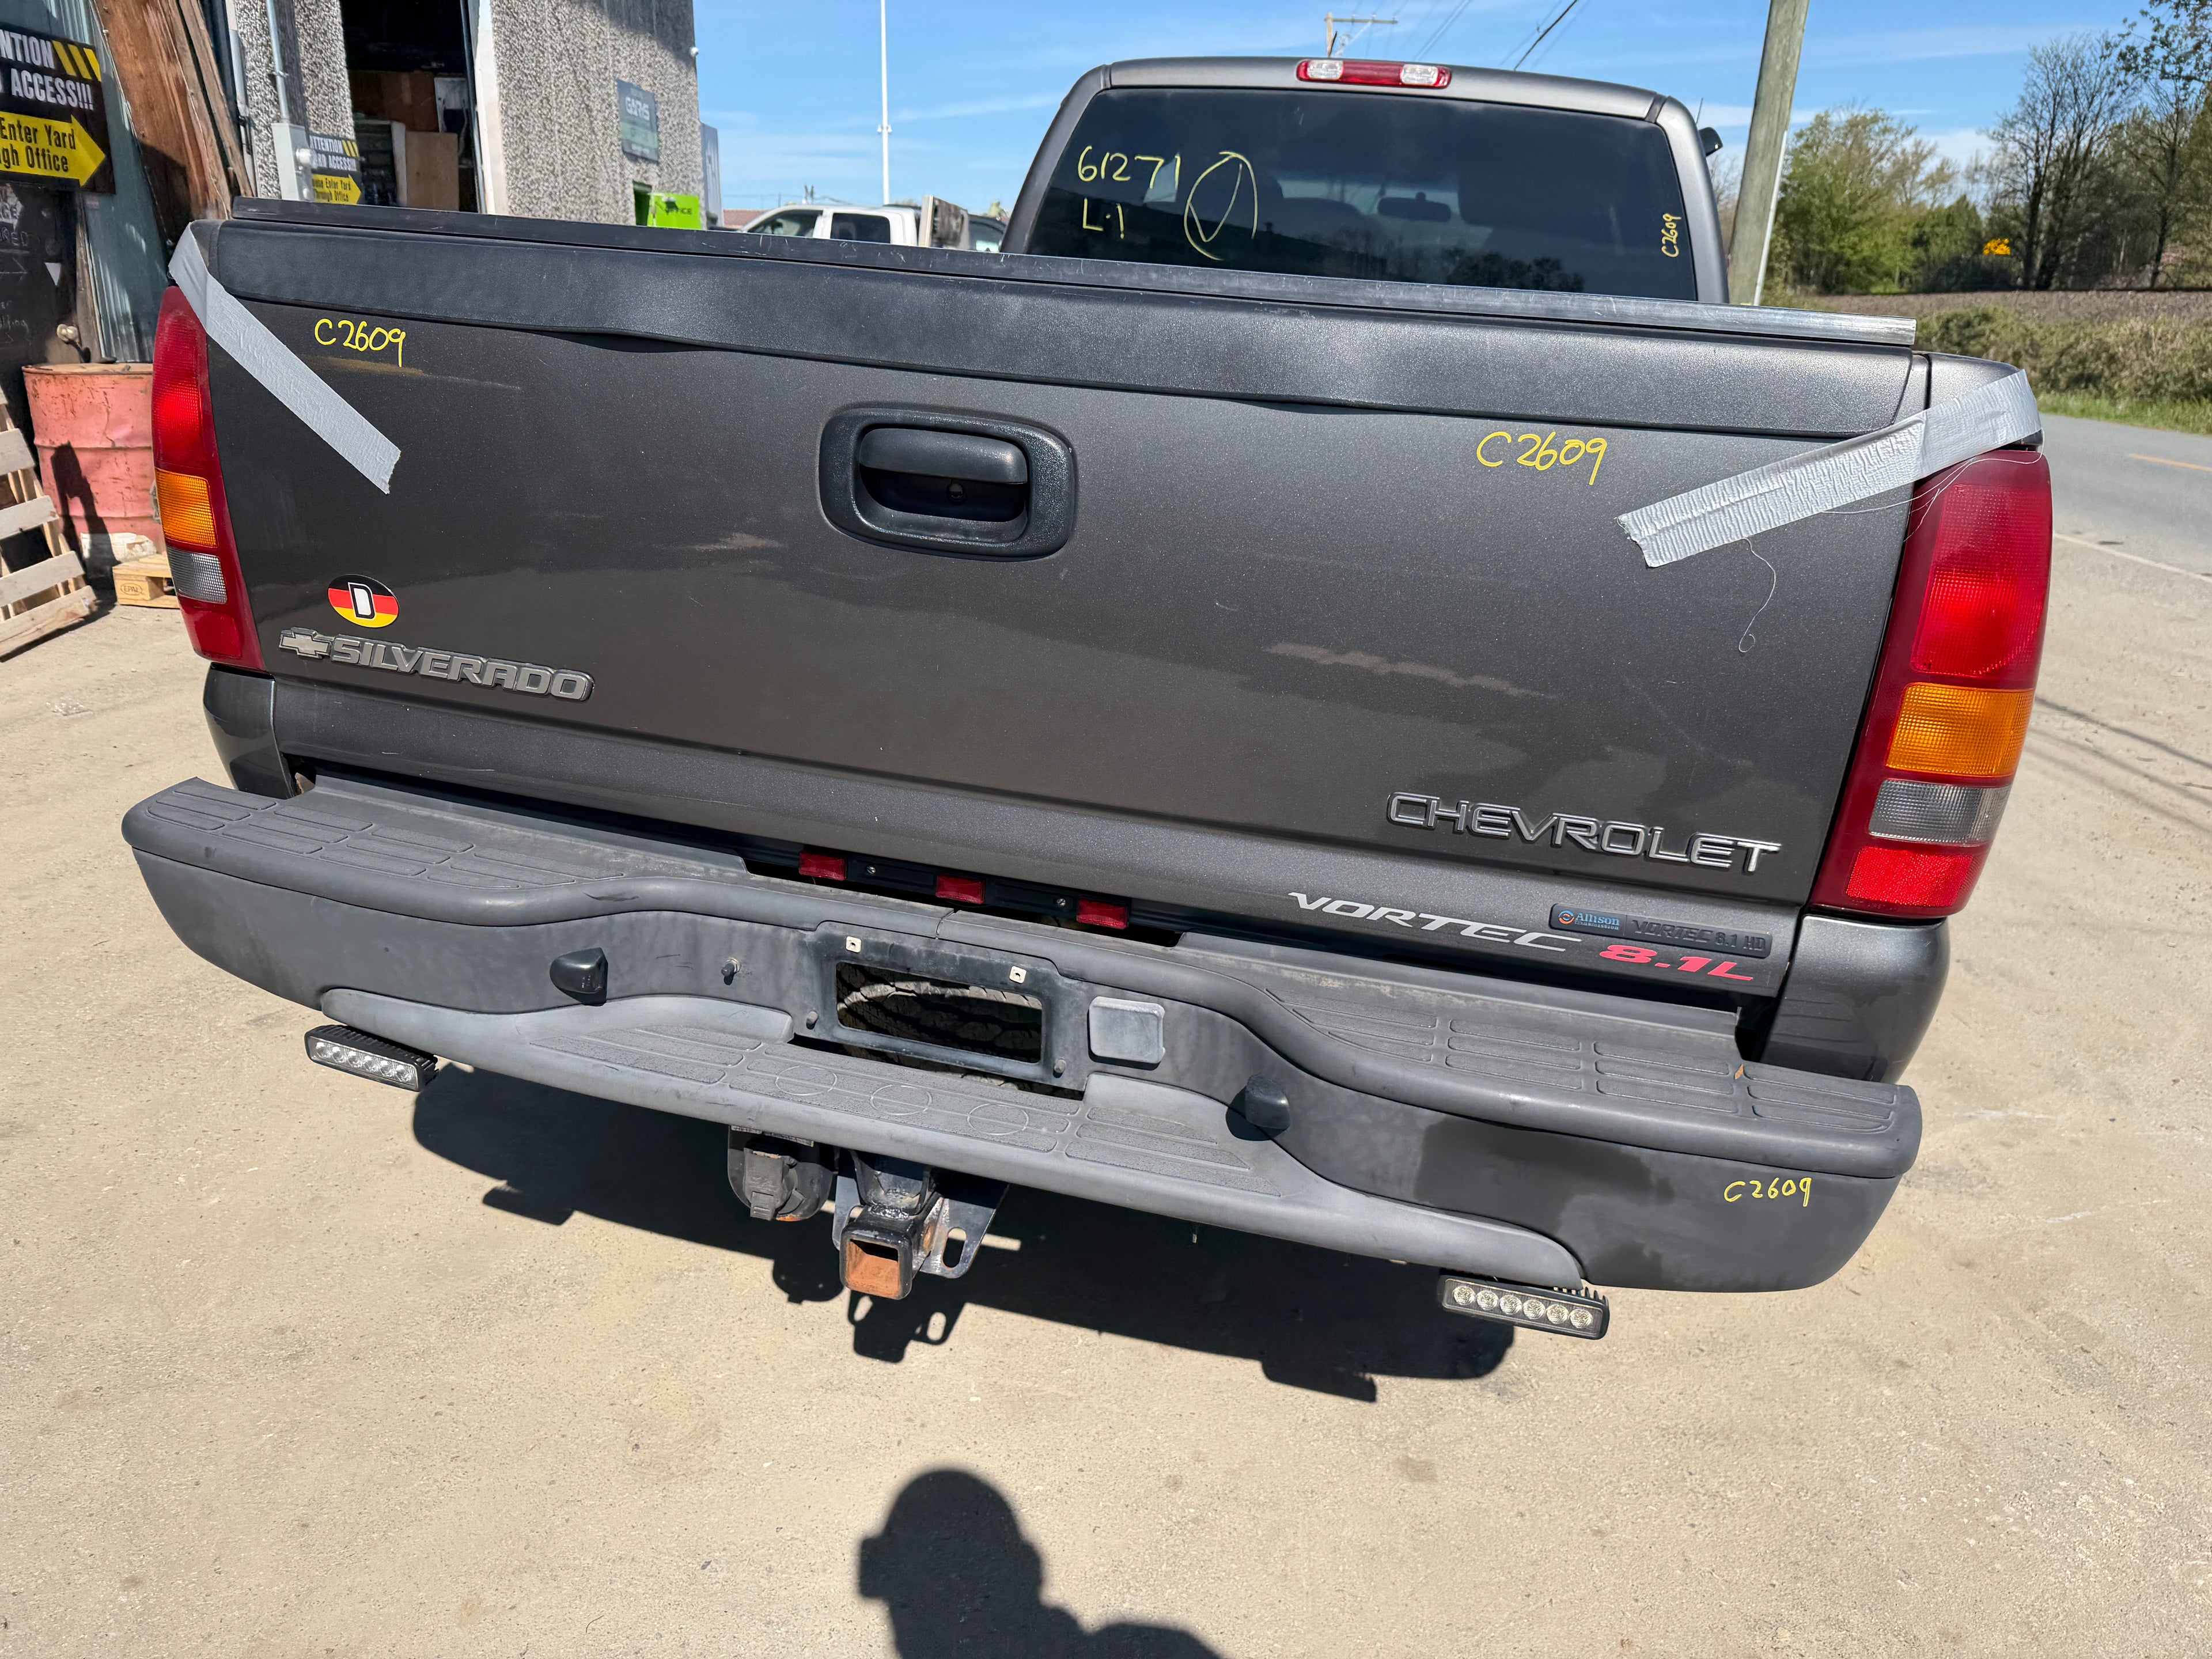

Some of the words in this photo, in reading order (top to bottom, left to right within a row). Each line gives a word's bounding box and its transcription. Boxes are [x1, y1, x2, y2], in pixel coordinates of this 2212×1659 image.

[10, 68, 93, 111] ACCESS!!!
[0, 117, 38, 145] Enter
[44, 124, 76, 150] Yard
[309, 135, 344, 154] ATTENTION
[0, 143, 20, 169] gh
[25, 145, 69, 172] Office
[1078, 145, 1181, 190] 61271
[1661, 213, 1681, 257] C2609
[315, 318, 406, 368] C2609
[1476, 431, 1608, 486] C2609
[347, 582, 376, 620] D
[331, 636, 593, 701] SILVERADO
[1388, 791, 1782, 874] CHEVROLET
[1287, 892, 1582, 952] VORTEC
[1599, 944, 1753, 982] 8.1L
[1575, 912, 1620, 926] Allison
[1631, 919, 1713, 944] VORTEC
[1714, 931, 1737, 948] 8.1
[1743, 934, 1766, 952] HD
[1724, 1177, 1812, 1207] C2609
